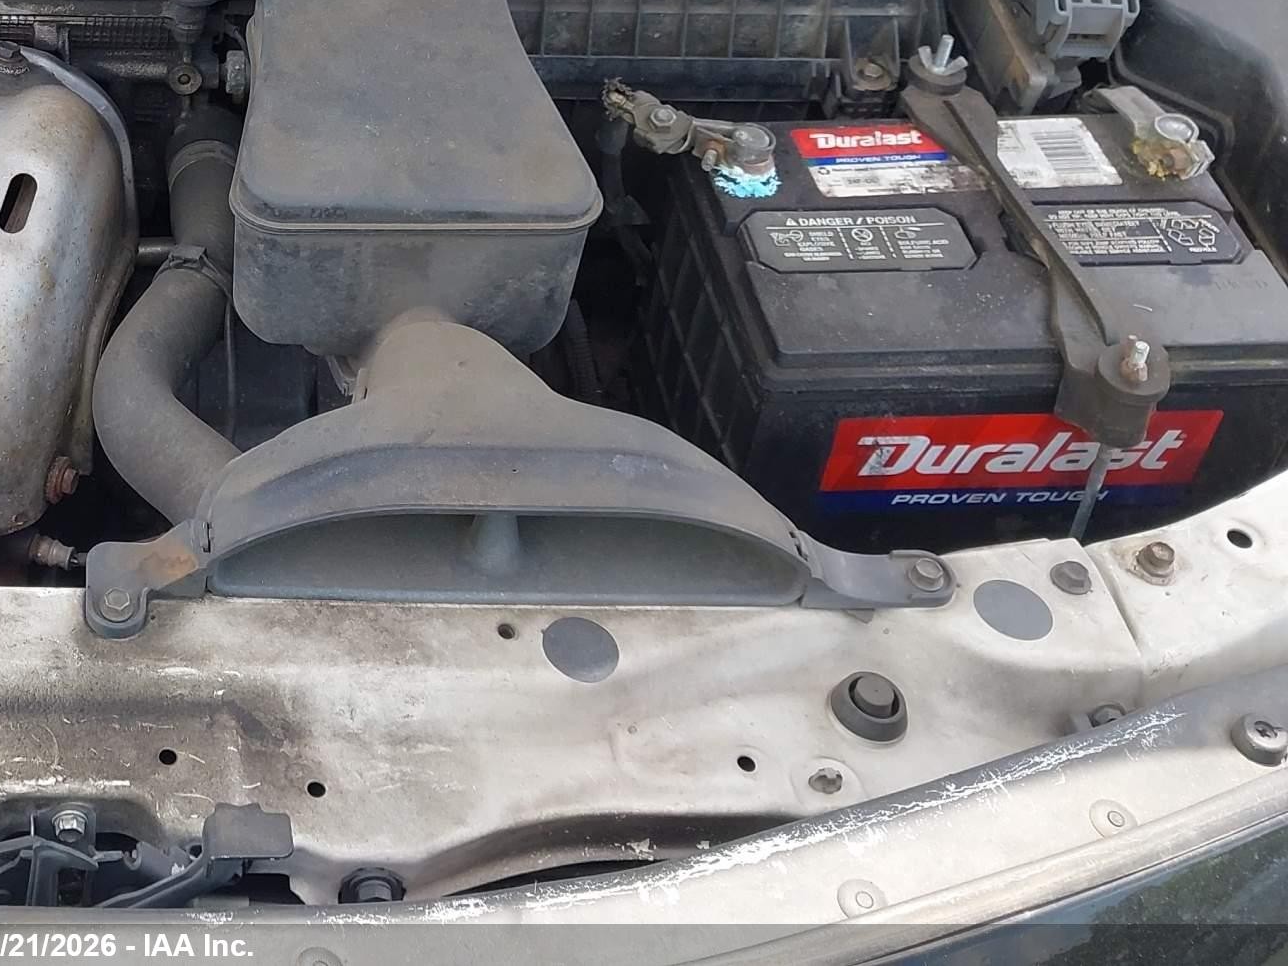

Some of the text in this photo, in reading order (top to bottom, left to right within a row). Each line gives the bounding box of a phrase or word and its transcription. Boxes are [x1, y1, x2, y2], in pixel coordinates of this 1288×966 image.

[809, 130, 924, 150] Duralast
[835, 154, 922, 164] PROVEN TOUGH
[798, 217, 854, 227] DANGER
[866, 215, 916, 225] POISON
[891, 492, 1007, 506] PROVEN
